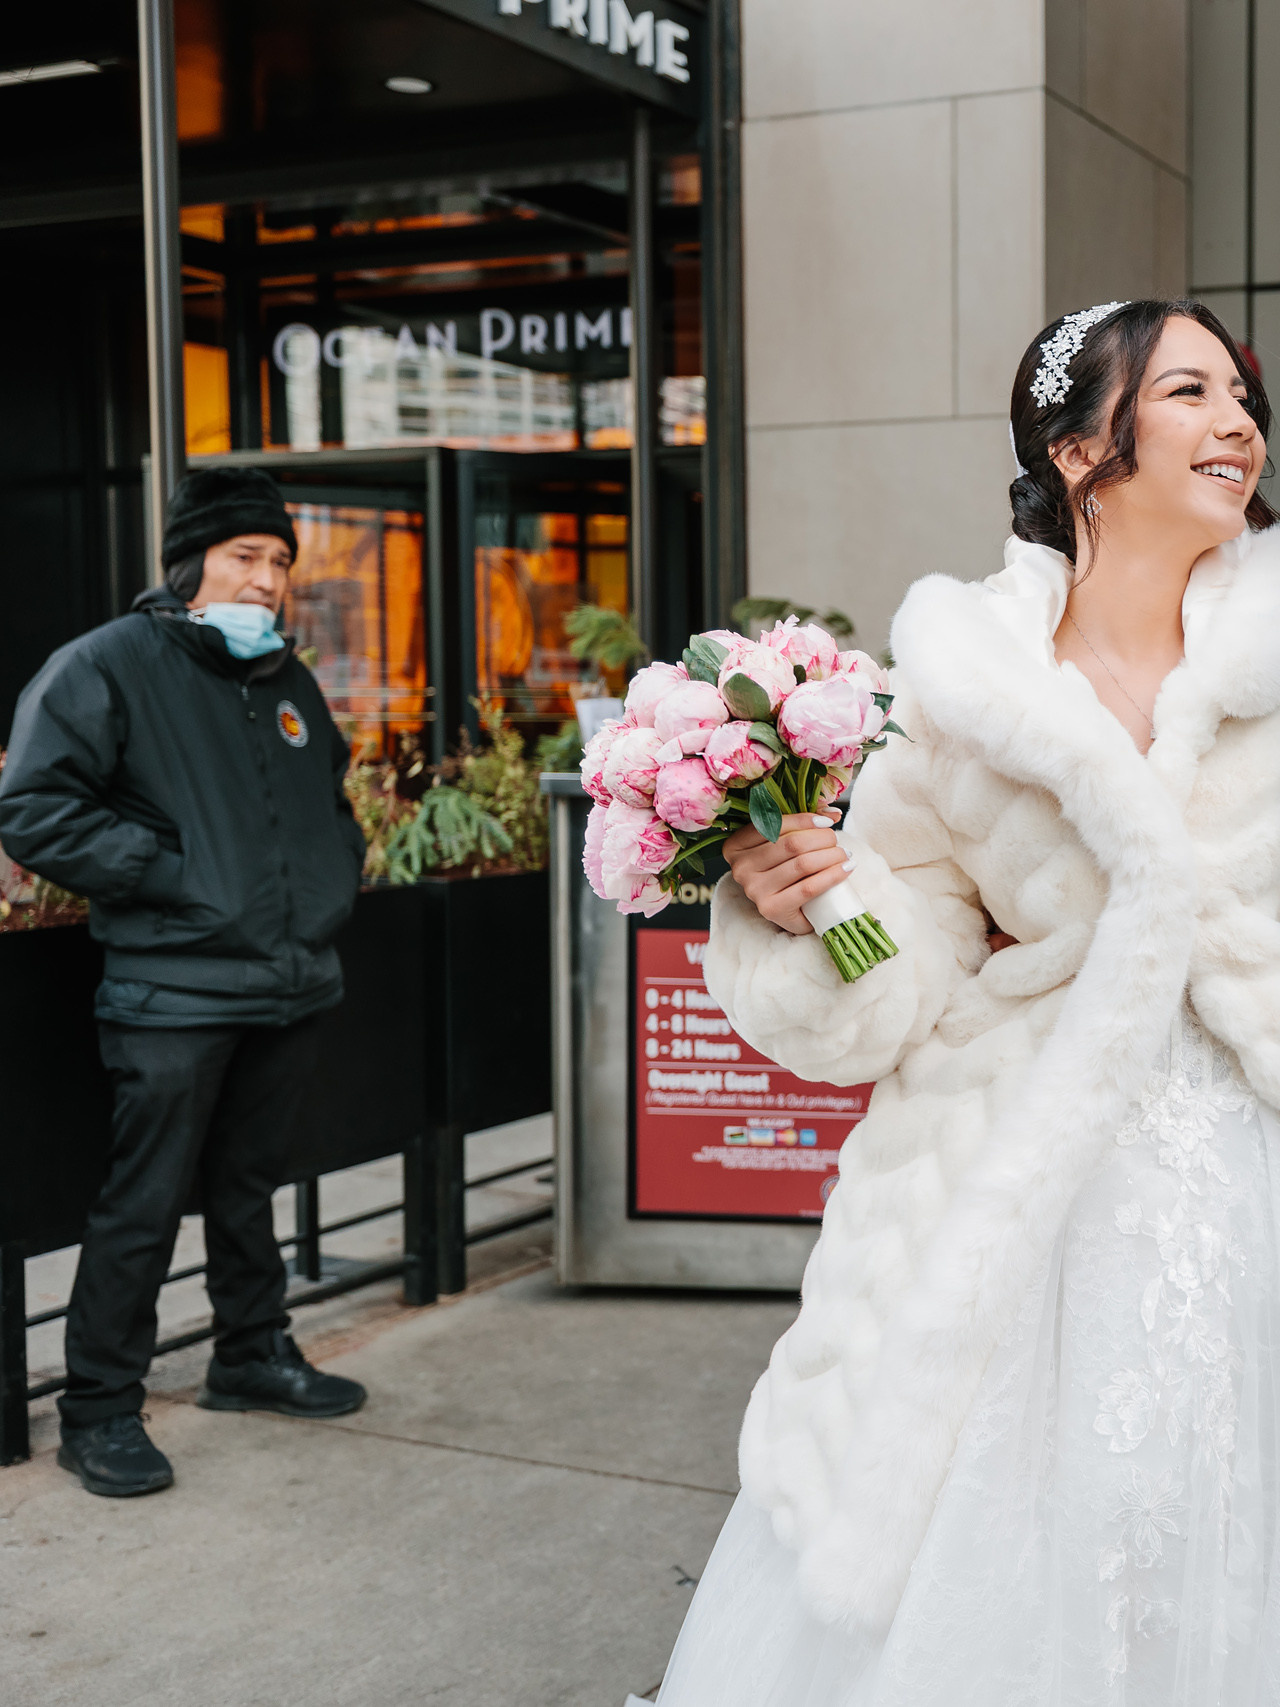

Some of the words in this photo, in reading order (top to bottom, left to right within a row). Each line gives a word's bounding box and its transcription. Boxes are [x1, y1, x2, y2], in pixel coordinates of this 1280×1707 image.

[671, 989, 683, 1009] 4
[645, 1013, 658, 1033] 4
[685, 1014, 732, 1035] Hours
[671, 1039, 692, 1059] 24
[694, 1039, 741, 1060] Hours
[648, 1069, 722, 1093] Overnight
[724, 1071, 768, 1092] Guest
